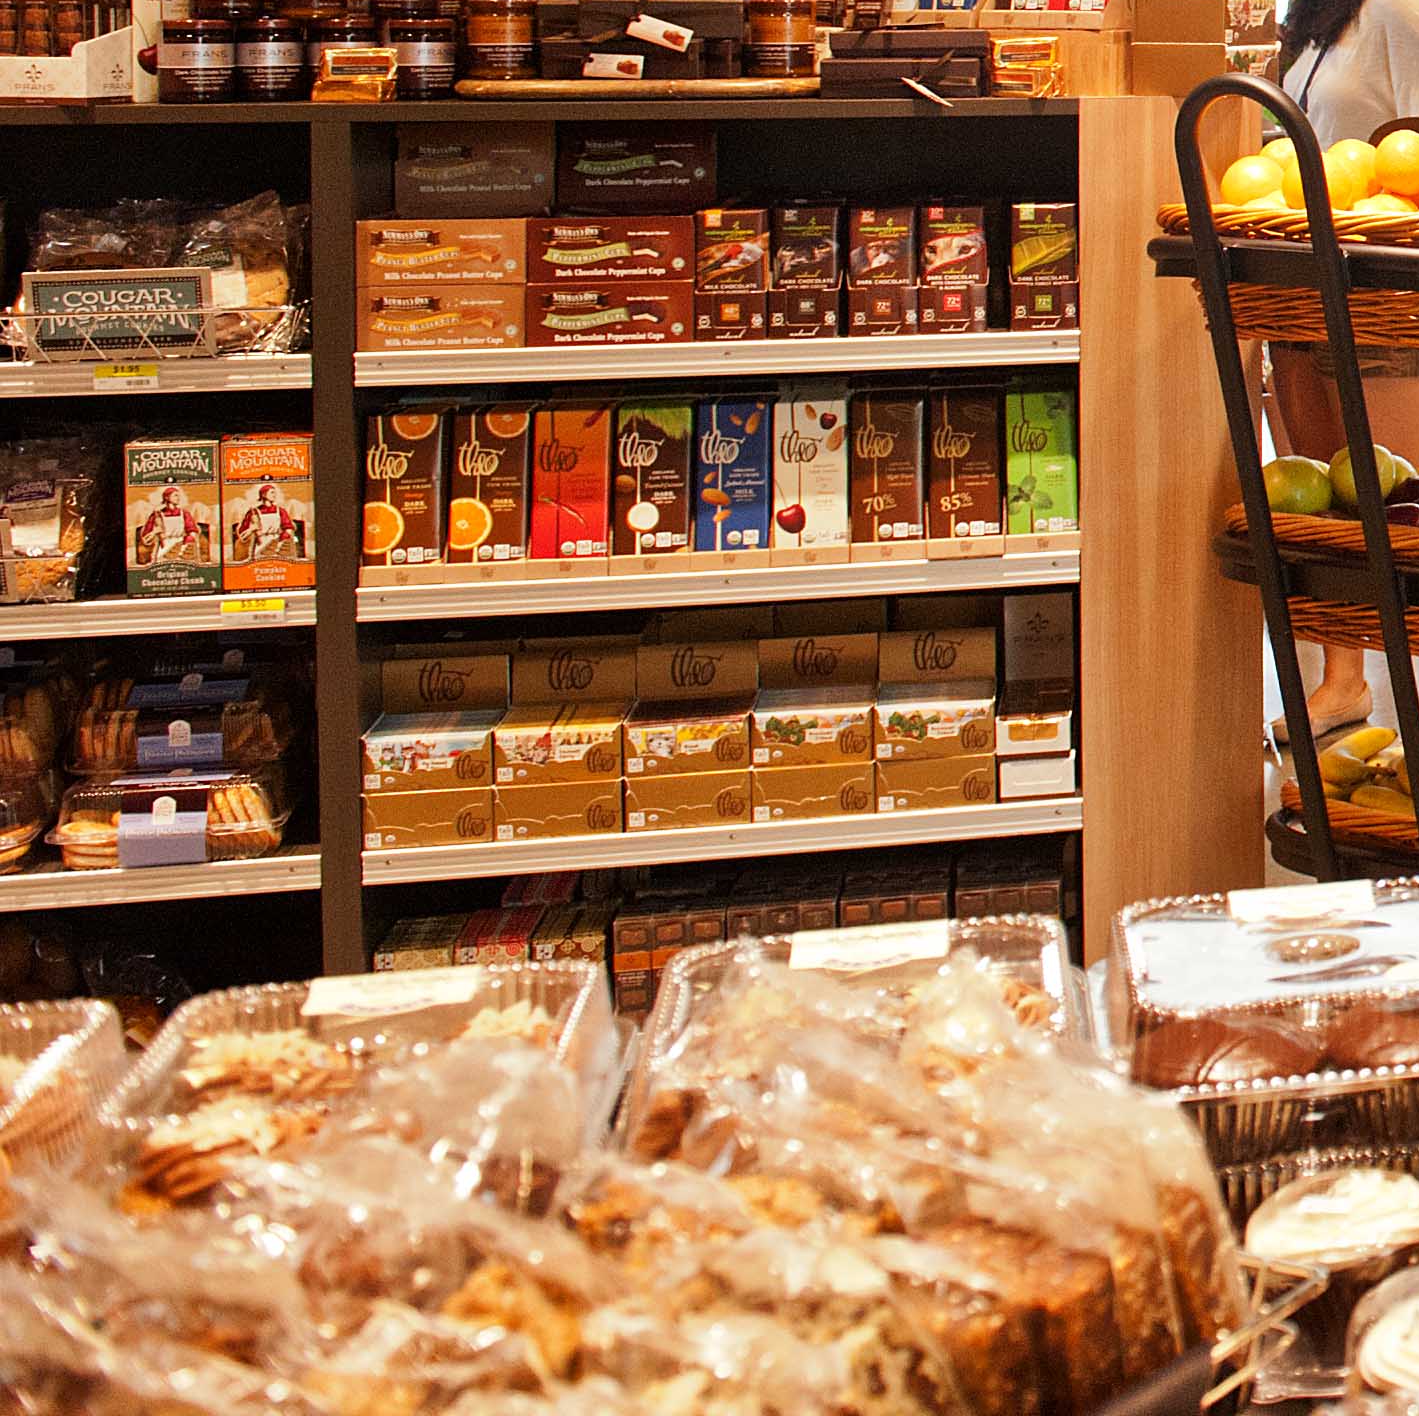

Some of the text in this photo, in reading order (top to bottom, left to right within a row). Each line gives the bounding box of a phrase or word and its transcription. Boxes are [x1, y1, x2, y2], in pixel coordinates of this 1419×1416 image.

[555, 267, 667, 277] Dark Chocolate Peppermint Cups
[797, 277, 834, 285] CHOCOLATE
[944, 273, 980, 281] CHOCOLATE
[62, 288, 176, 308] COUGAR
[618, 432, 665, 467] theo
[701, 429, 746, 464] theo
[780, 430, 823, 463] theo
[856, 424, 899, 458] theo
[934, 425, 976, 458] theo
[1011, 421, 1052, 453] theo
[140, 449, 200, 461] COUGAR
[230, 455, 305, 473] MOUNTAIN
[237, 447, 297, 458] COUGAR
[367, 444, 415, 479] theo
[458, 440, 506, 476] theo
[540, 439, 586, 473] theo
[132, 457, 210, 477] MOUNTAIN
[863, 493, 897, 514] 70%
[940, 492, 974, 512] 85%
[141, 577, 179, 587] Chocolate
[157, 570, 189, 579] Original
[793, 637, 846, 677] theo
[913, 631, 964, 671] theo
[548, 647, 603, 691] theo
[671, 646, 724, 688] theo
[419, 661, 474, 703] theo
[715, 736, 748, 762] theo
[960, 723, 992, 749] theo
[456, 753, 490, 780] theo
[586, 747, 618, 773] theo
[963, 776, 993, 802] theo
[586, 803, 620, 830] theo
[717, 791, 749, 817] theo
[457, 811, 491, 837] theo
